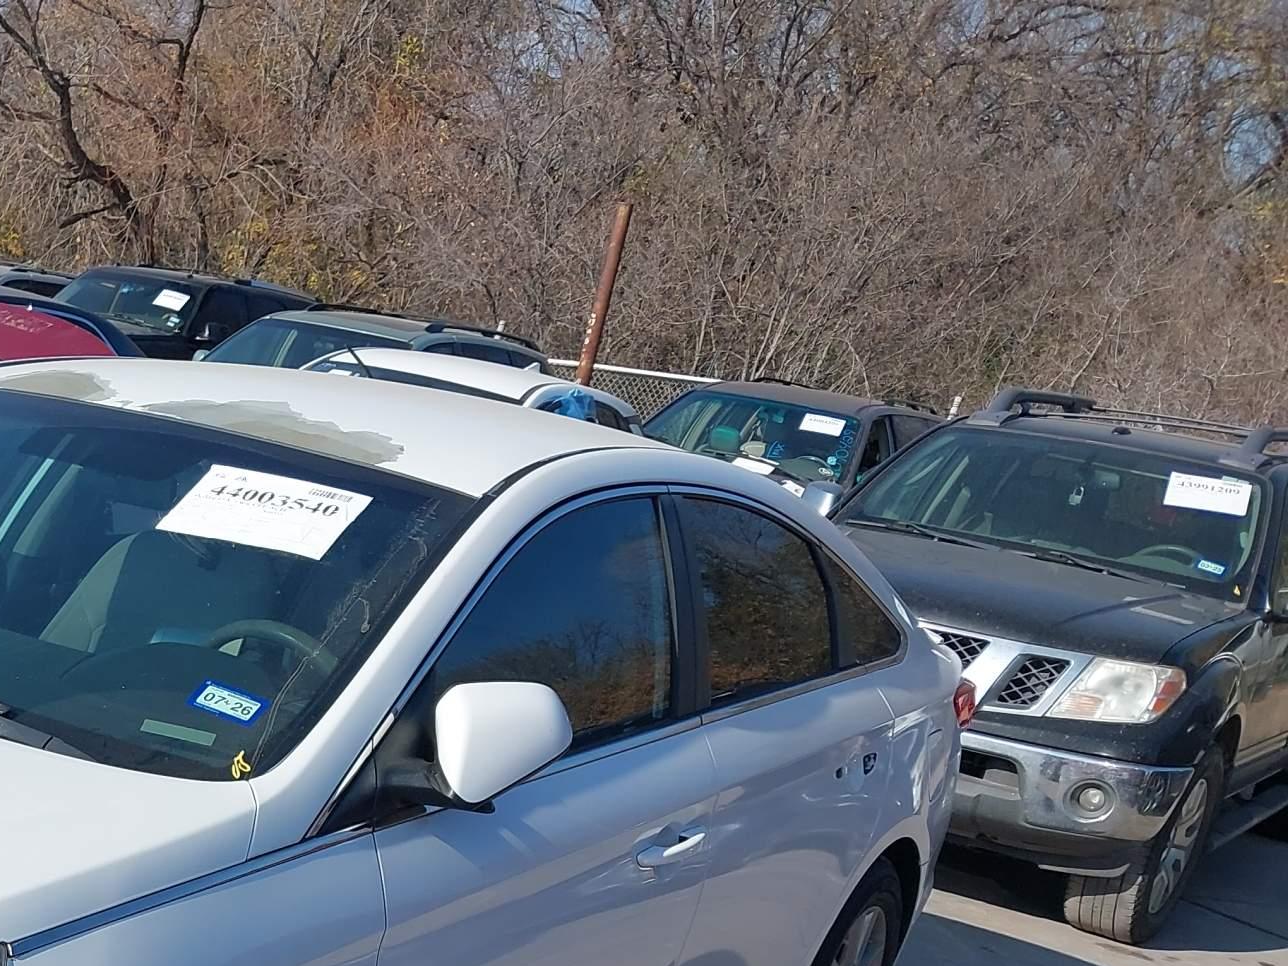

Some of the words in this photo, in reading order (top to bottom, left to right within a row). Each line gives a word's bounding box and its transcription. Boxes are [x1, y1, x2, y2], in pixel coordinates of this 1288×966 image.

[1175, 480, 1241, 495] 43991209
[211, 484, 340, 517] 44003540
[203, 692, 227, 705] 07
[230, 702, 253, 716] 26
